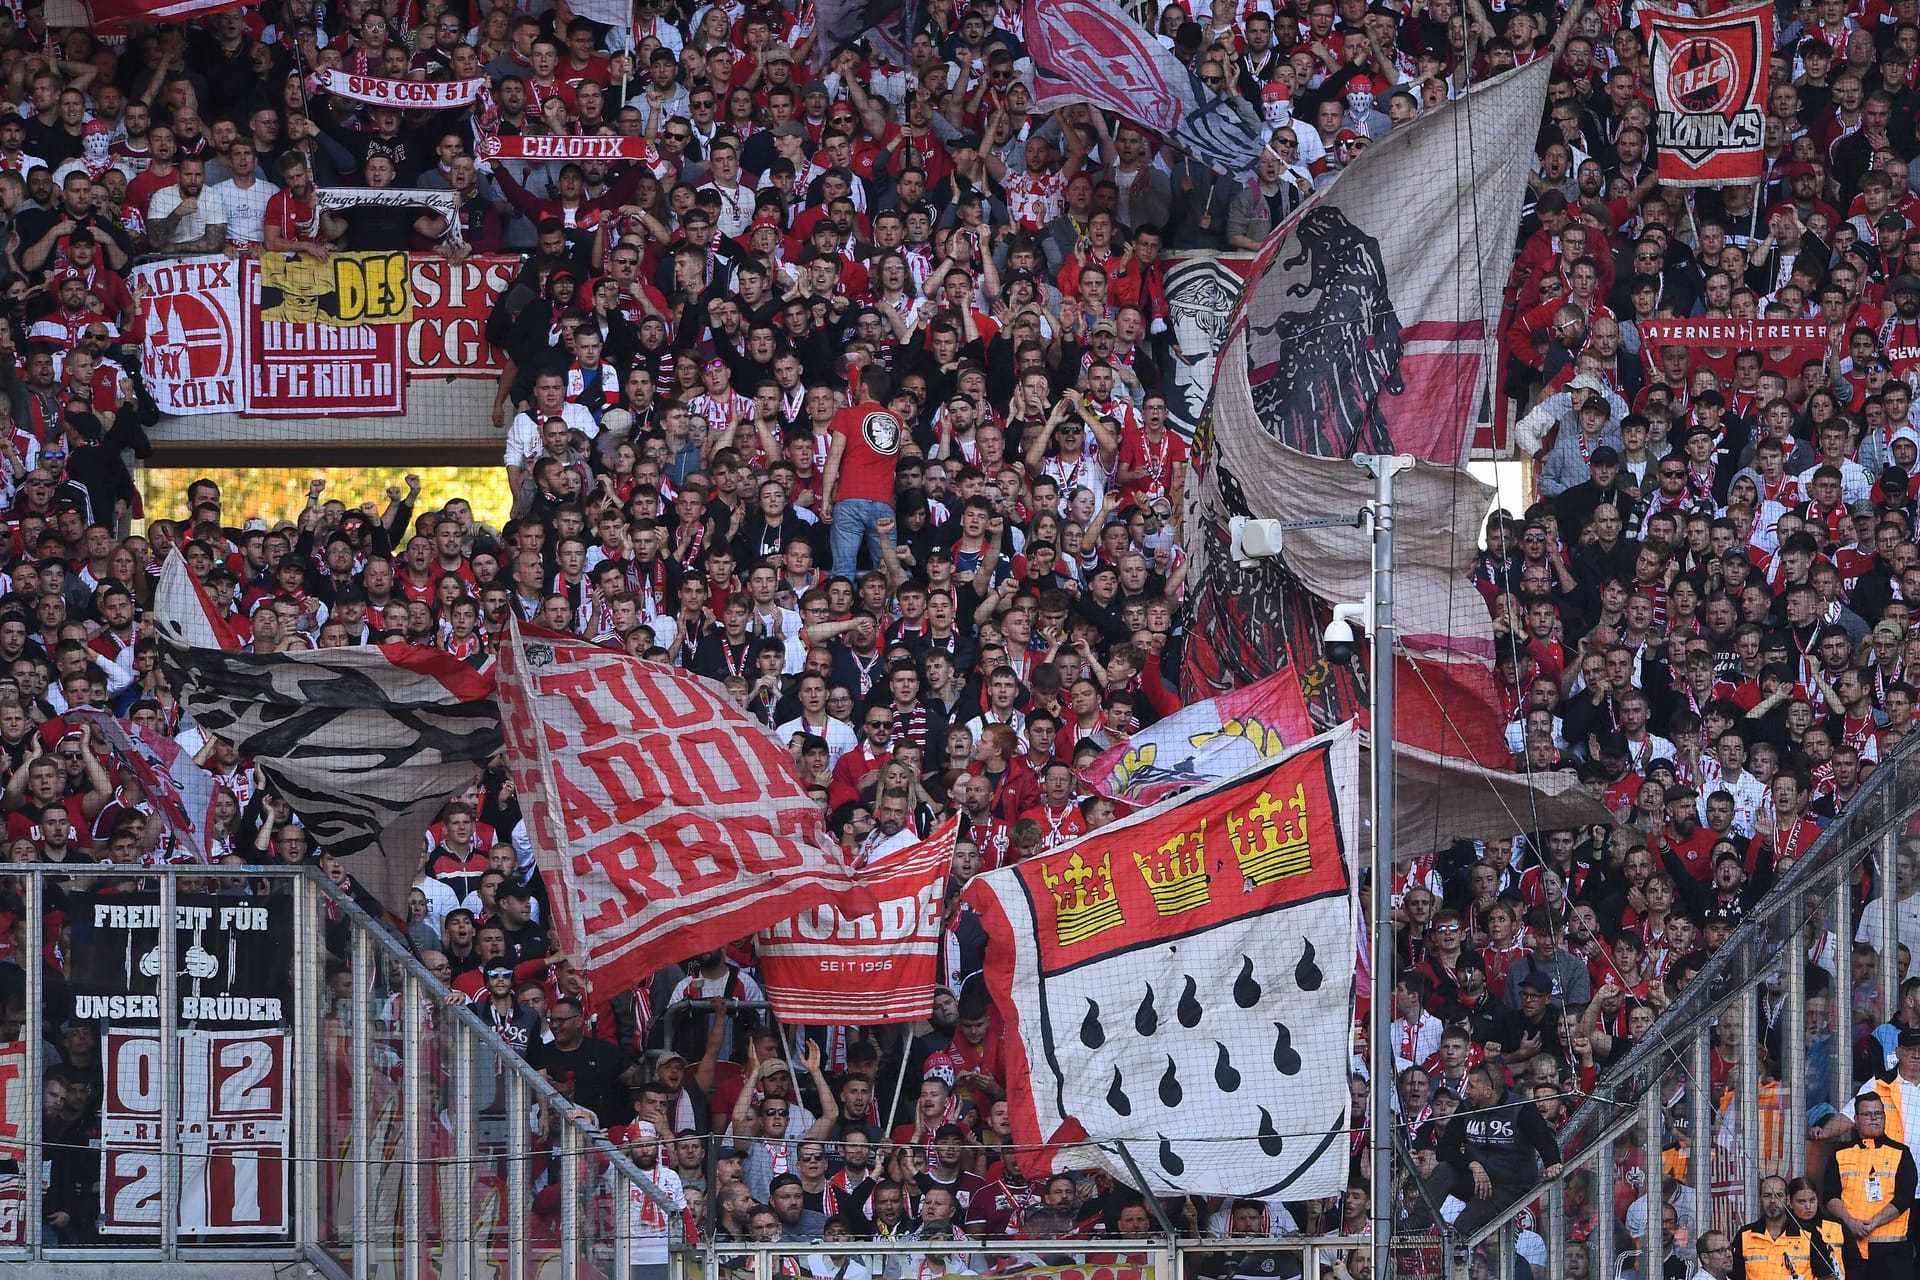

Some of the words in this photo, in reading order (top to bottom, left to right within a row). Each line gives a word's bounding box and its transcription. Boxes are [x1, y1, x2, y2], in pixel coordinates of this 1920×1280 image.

[348, 76, 389, 98] SPS
[394, 83, 440, 101] CGN
[445, 80, 469, 101] 51
[1656, 112, 1761, 147] OLONIACS
[522, 136, 622, 158] CHAOTIX
[137, 261, 232, 299] AOTIX
[333, 252, 409, 321] DES
[1641, 326, 1735, 340] LATERNEN
[1757, 325, 1827, 339] TRETER
[1889, 346, 1920, 361] REW
[168, 379, 235, 408] KÖLN
[552, 726, 811, 843] ADION
[573, 807, 838, 936] ERBOT
[94, 904, 212, 931] FREIEIT
[219, 901, 269, 931] FÜR
[760, 877, 943, 940] ORDE
[820, 960, 856, 972] SEIT
[860, 960, 893, 972] 1996
[75, 995, 162, 1019] UNSER
[182, 992, 283, 1021] BRÜDER
[219, 1040, 273, 1112] 2
